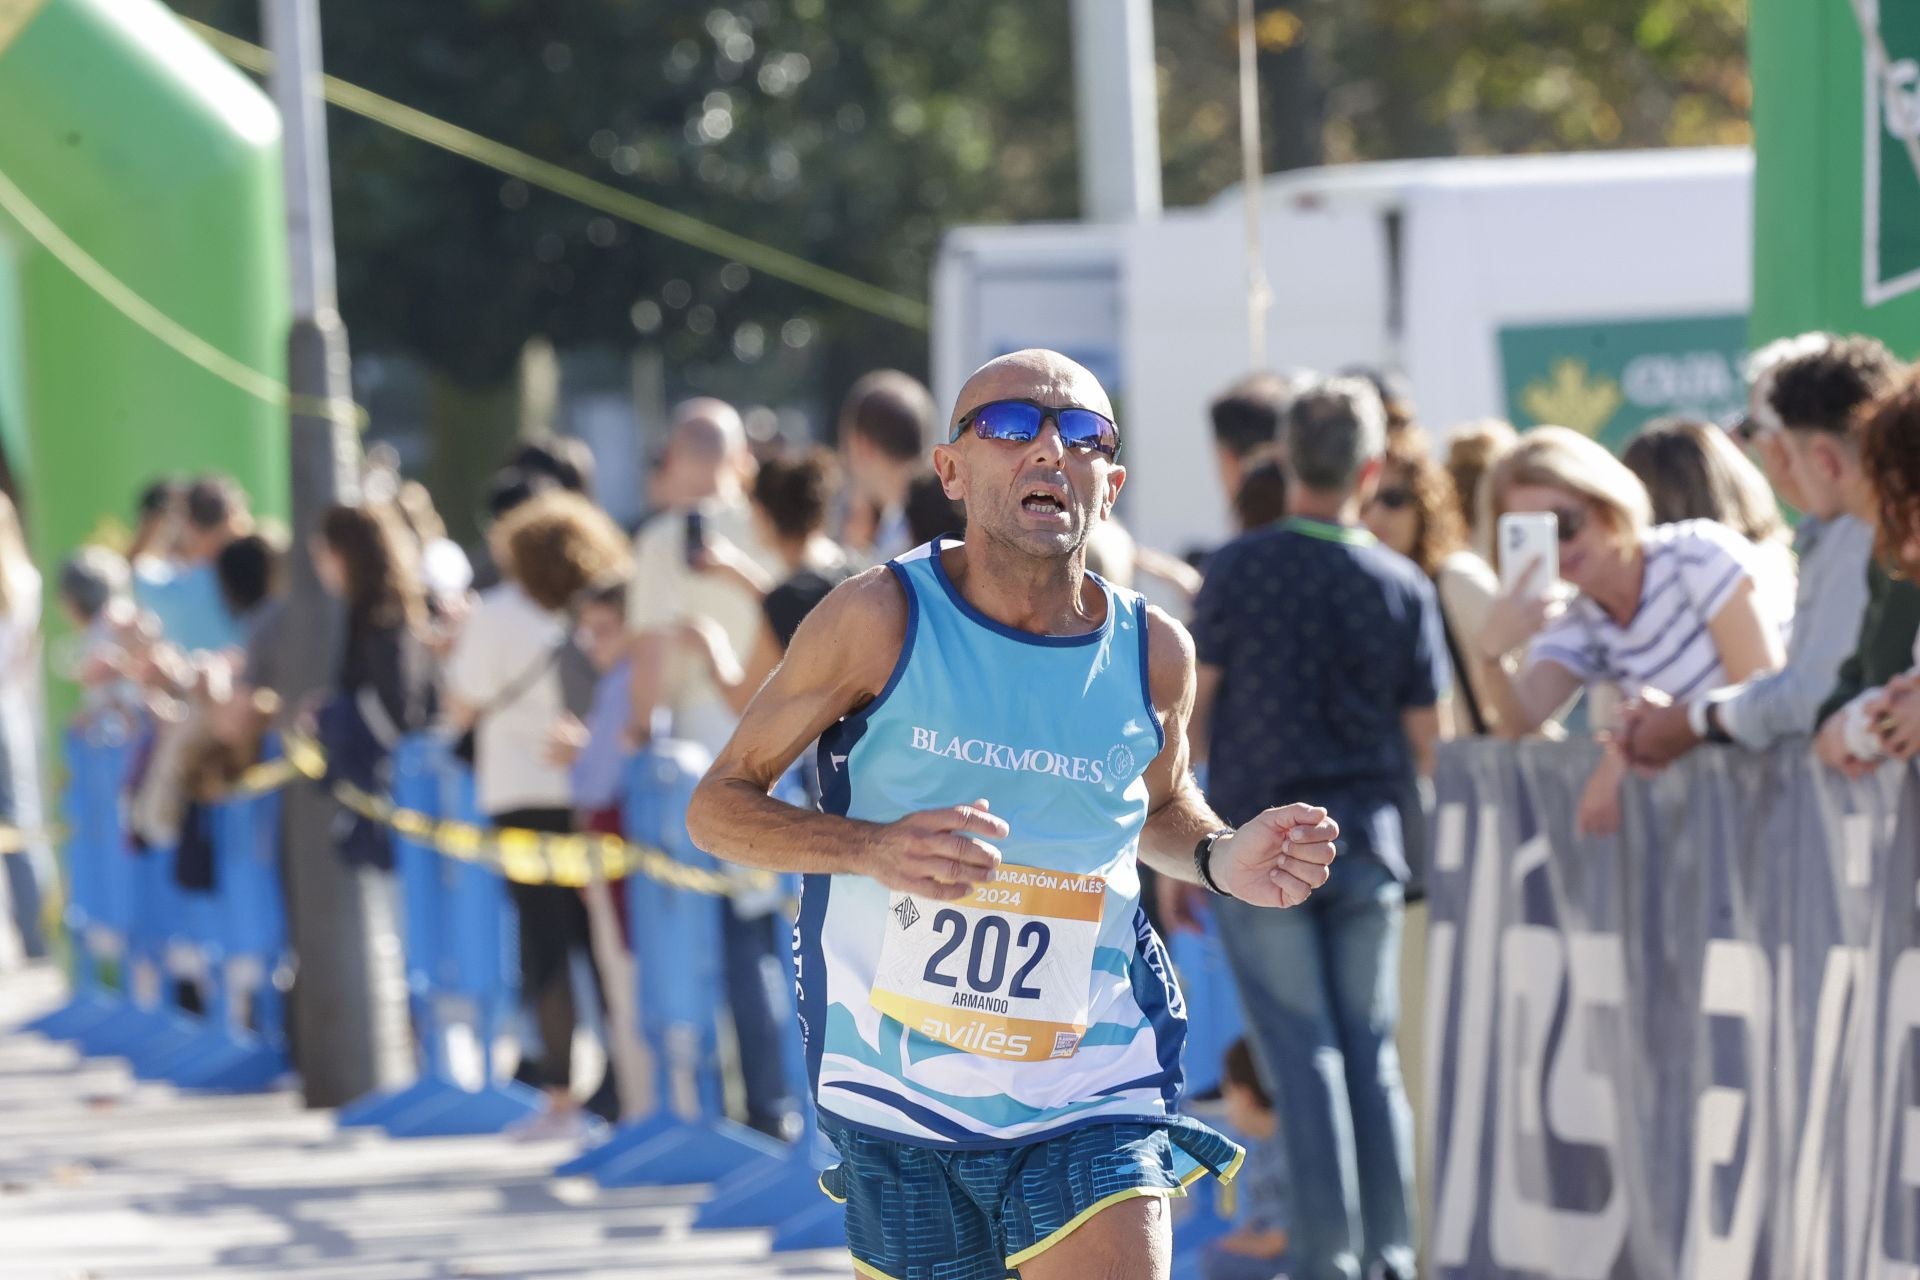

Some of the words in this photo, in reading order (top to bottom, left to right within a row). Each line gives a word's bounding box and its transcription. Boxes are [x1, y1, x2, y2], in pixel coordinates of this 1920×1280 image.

[911, 726, 1103, 784] BLACKMORES
[975, 887, 1022, 906] 2024
[1059, 877, 1103, 894] AVILÉS
[922, 908, 1051, 1000] 202
[952, 992, 1008, 1014] ARMANDO
[921, 1017, 1032, 1057] avilés
